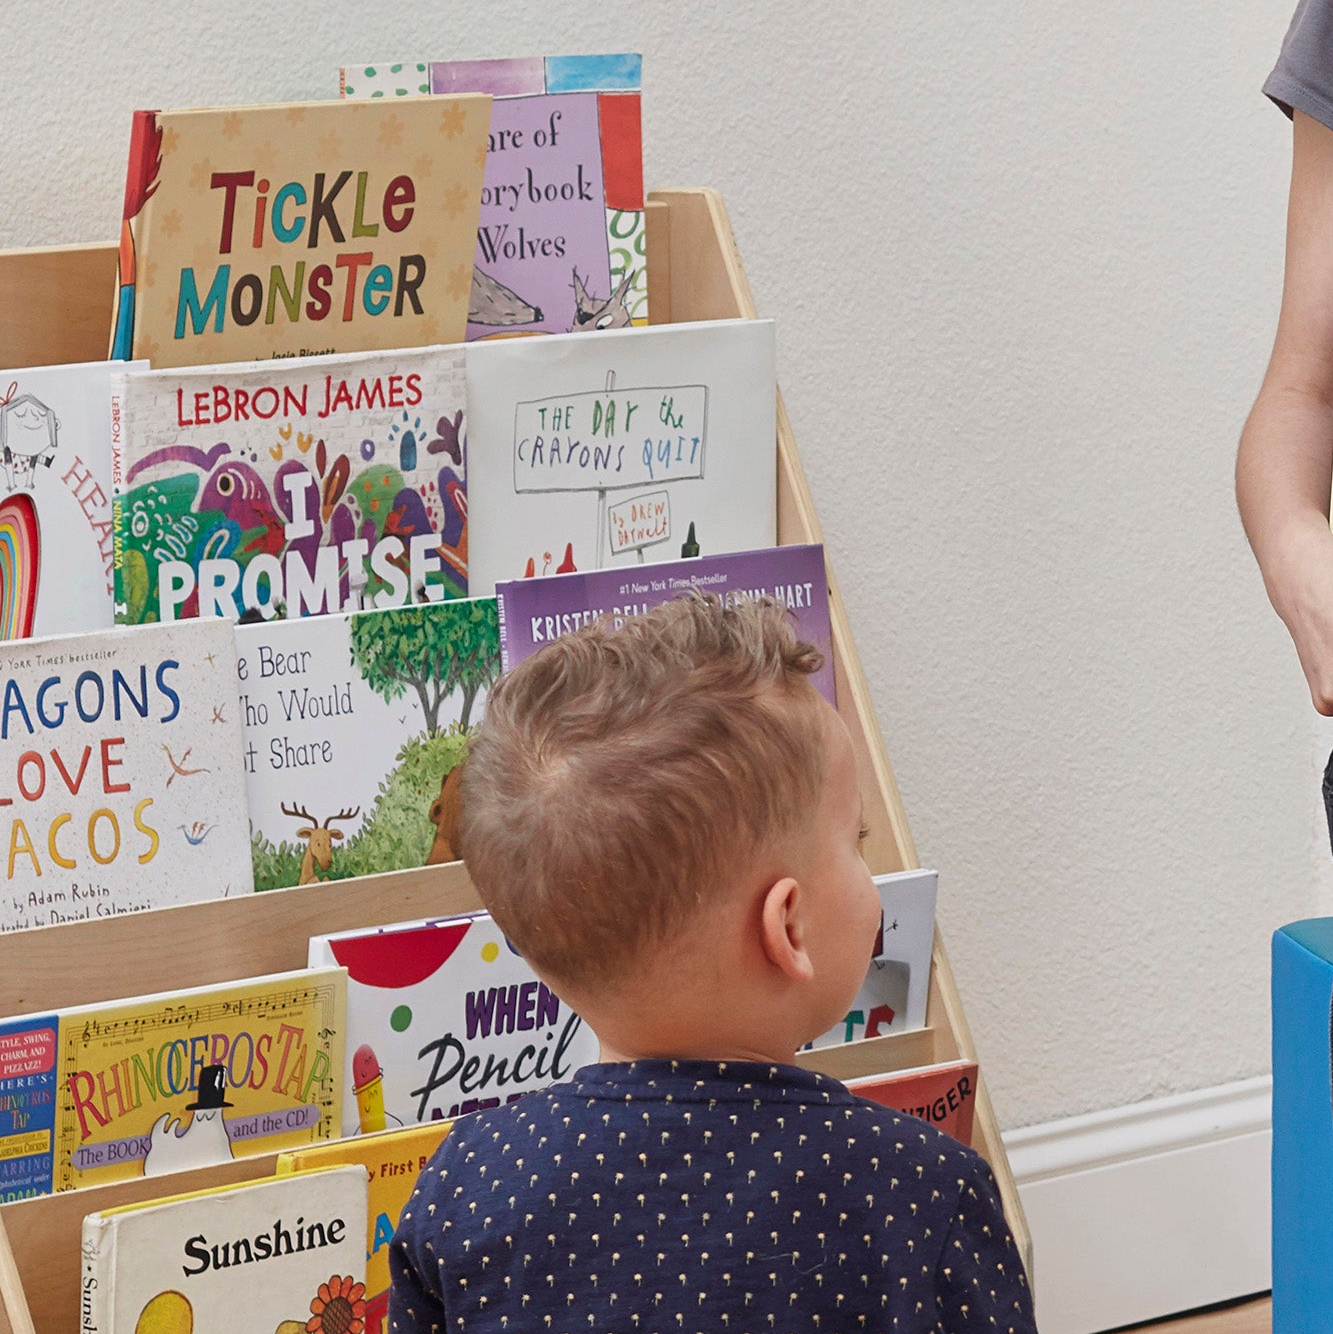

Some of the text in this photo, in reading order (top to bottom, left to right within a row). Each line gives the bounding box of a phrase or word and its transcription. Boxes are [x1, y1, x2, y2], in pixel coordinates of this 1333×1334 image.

[533, 109, 562, 148] of
[477, 223, 566, 264] Wolves
[317, 373, 423, 419] JAMES
[538, 395, 684, 439] THE DAY the
[517, 435, 700, 480] CRAYONS QUIT
[282, 471, 315, 541] I
[631, 501, 665, 523] DREW
[631, 582, 649, 594] New
[651, 580, 667, 592] York
[258, 645, 313, 678] Bear
[277, 682, 355, 722] Would
[269, 736, 333, 770] Share
[13, 883, 110, 914] by Adam Rubin
[466, 981, 560, 1040] WHEN
[410, 1012, 582, 1123] Pencil
[232, 1109, 310, 1138] and the CD!
[77, 1137, 151, 1166] The BOOK
[380, 1159, 414, 1178] First
[182, 1216, 346, 1277] Sunshine
